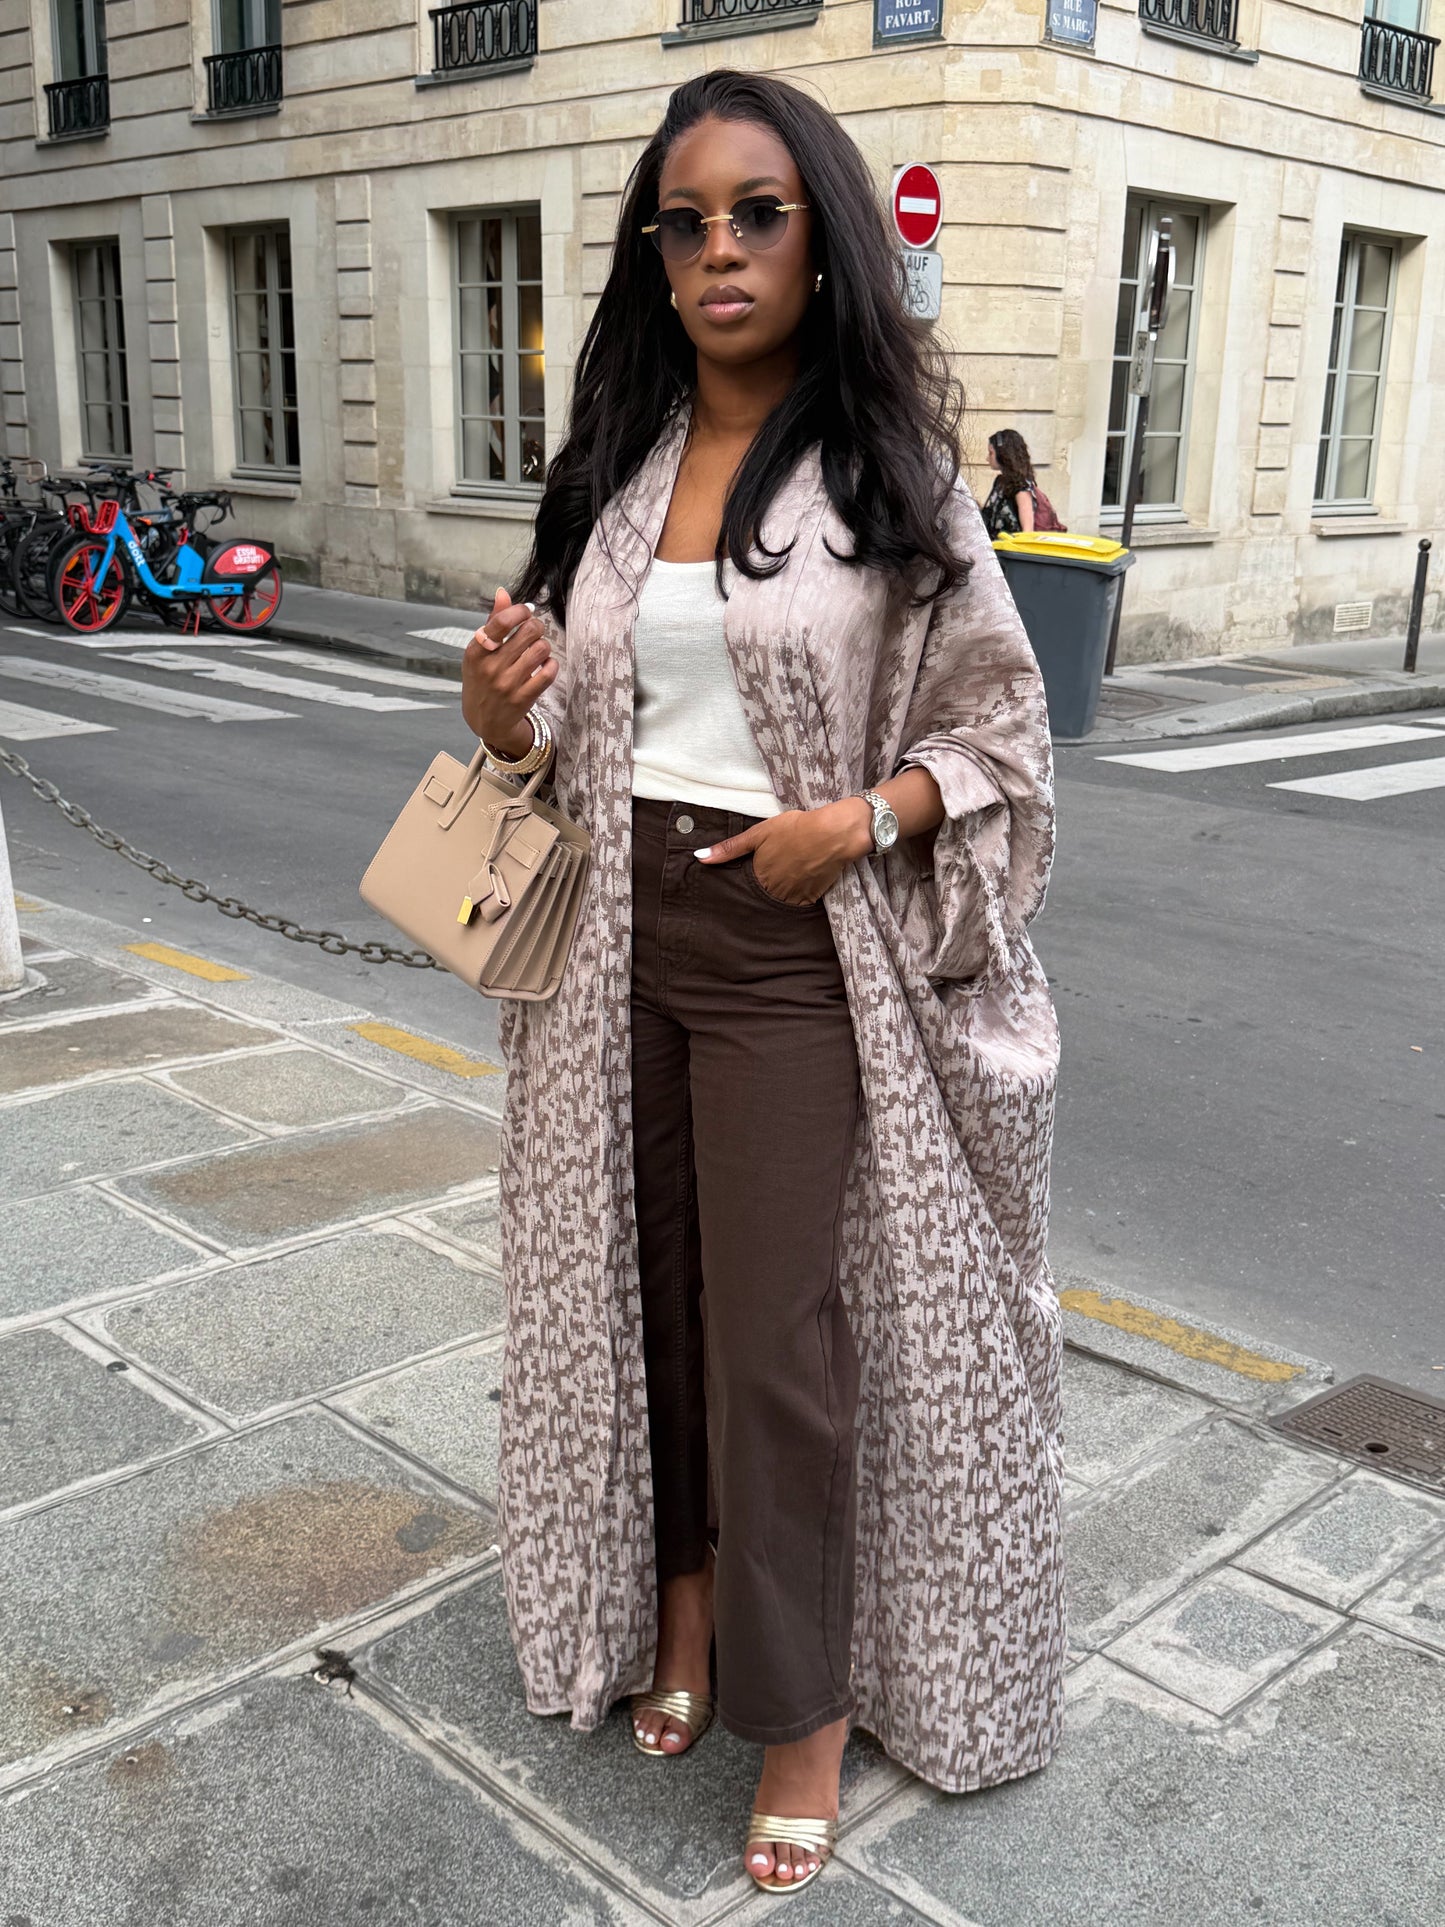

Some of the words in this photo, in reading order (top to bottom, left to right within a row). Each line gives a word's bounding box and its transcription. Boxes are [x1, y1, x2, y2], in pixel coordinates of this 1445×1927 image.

[885, 10, 935, 28] FAVART.
[1063, 15, 1091, 34] MARC.
[906, 256, 928, 271] AUF
[128, 540, 146, 568] dott
